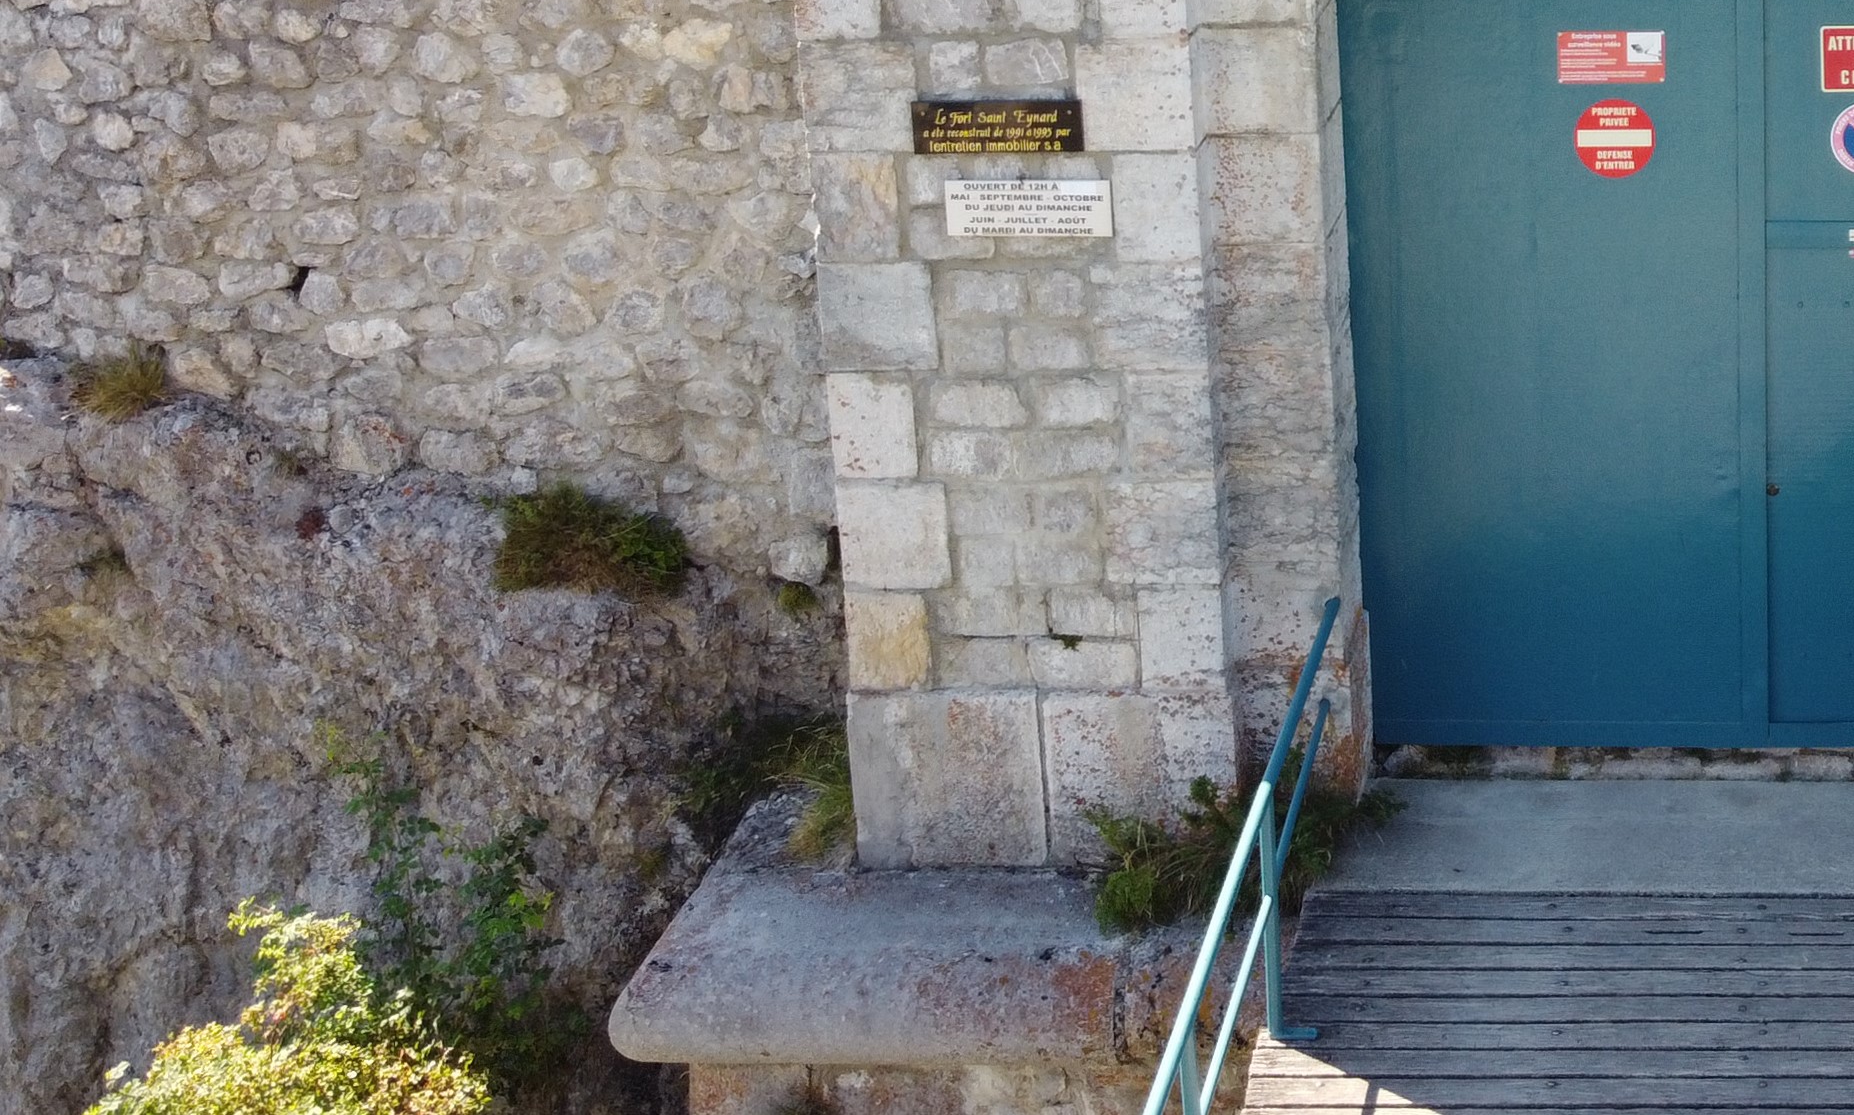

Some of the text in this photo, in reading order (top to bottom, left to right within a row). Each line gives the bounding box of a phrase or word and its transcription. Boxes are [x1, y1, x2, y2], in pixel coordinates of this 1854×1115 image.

[935, 108, 1058, 127] Le Fort Saint Eynard
[947, 128, 991, 138] reconstruit
[994, 129, 1003, 137] de
[1007, 128, 1024, 139] 1991
[1056, 128, 1071, 139] par
[986, 139, 1040, 151] immobilier
[1057, 216, 1087, 224] AOÛT
